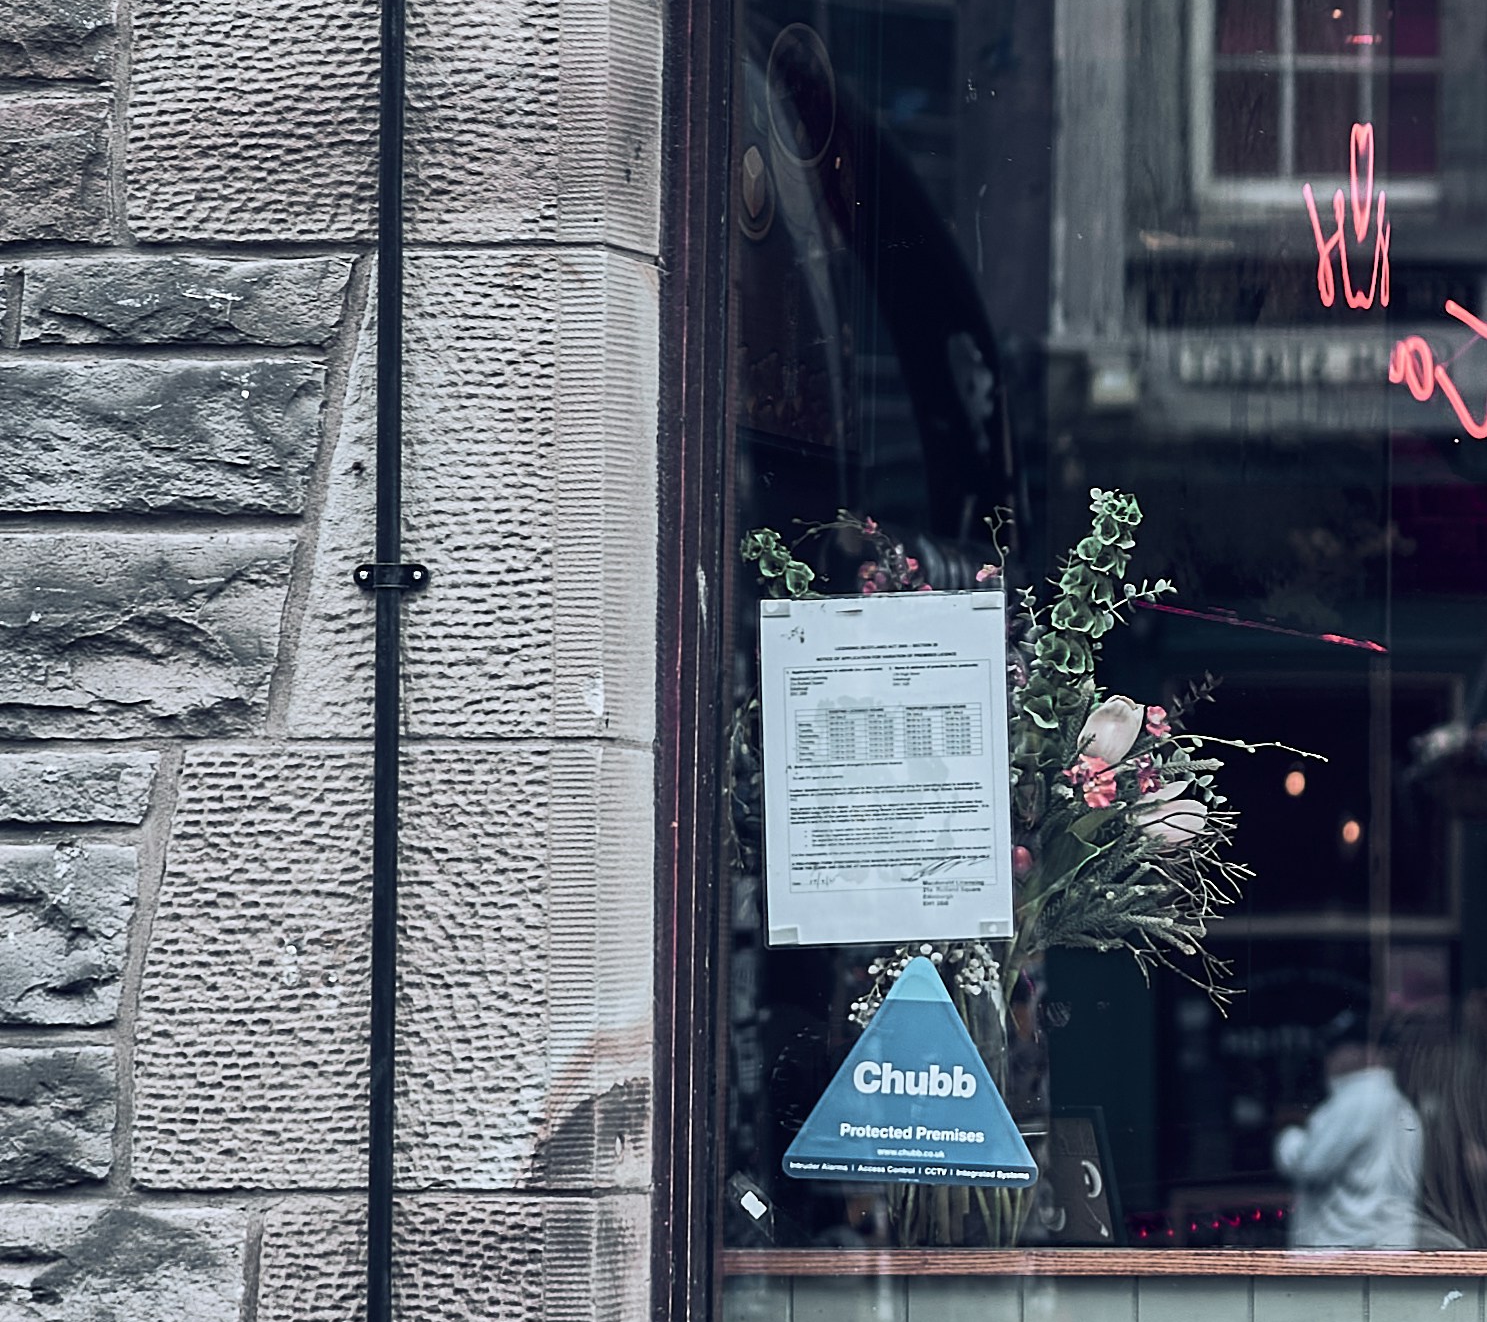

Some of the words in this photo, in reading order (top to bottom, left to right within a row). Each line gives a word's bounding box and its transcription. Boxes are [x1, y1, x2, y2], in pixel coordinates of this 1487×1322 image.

[852, 1060, 977, 1099] Chubb
[839, 1122, 913, 1141] Protected
[915, 1125, 985, 1144] Premises
[876, 1148, 946, 1159] www.chubb.co.uk
[857, 1164, 886, 1174] Access
[887, 1165, 916, 1175] Control
[924, 1167, 948, 1177] CCTV
[955, 1169, 996, 1179] Integrated
[996, 1170, 1030, 1181] Systems
